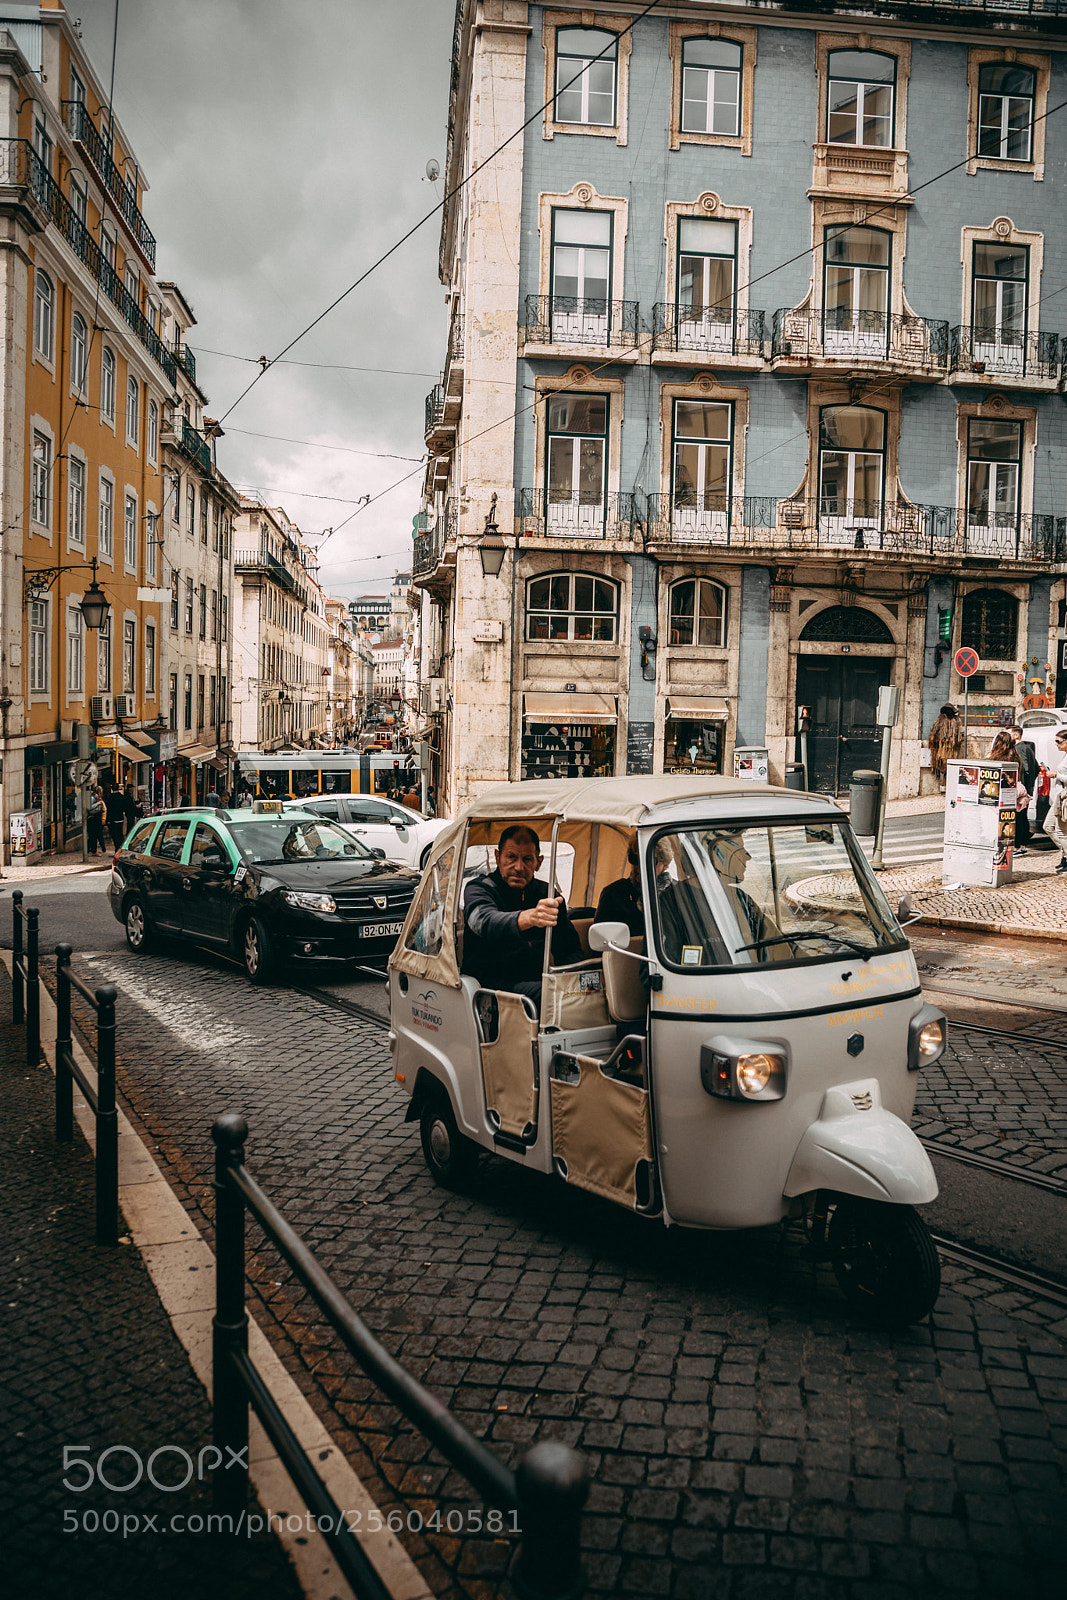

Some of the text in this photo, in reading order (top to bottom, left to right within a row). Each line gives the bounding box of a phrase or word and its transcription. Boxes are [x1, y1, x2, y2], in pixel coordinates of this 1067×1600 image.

[670, 766, 716, 775] Gelato Therapy
[980, 769, 1000, 780] COLO
[1000, 811, 1016, 820] COLO
[857, 961, 908, 978] BOOK NOW
[829, 980, 865, 996] TOURS
[656, 994, 717, 1011] TRANSFER
[827, 1005, 885, 1027] ANYWHERE
